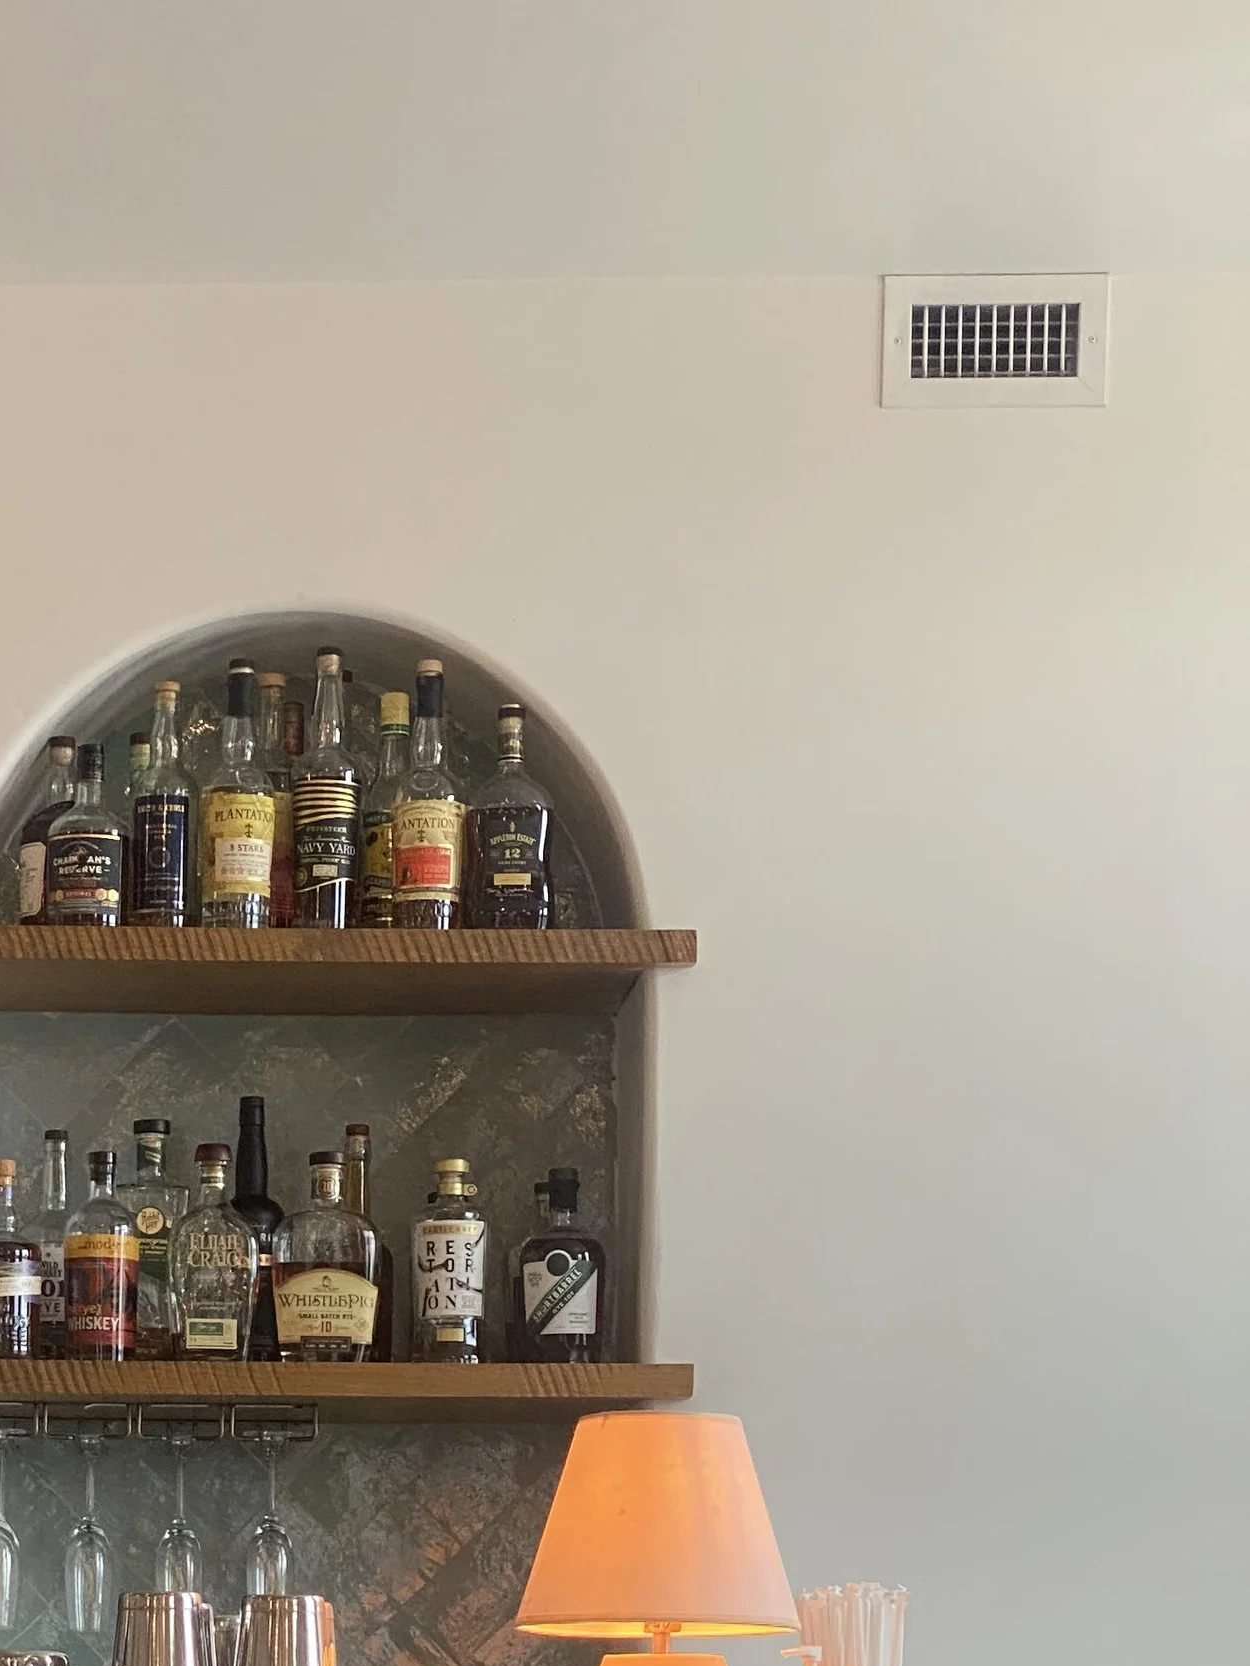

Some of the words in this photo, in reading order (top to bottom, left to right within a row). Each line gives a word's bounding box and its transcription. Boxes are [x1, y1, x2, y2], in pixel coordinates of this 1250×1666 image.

[400, 817, 456, 830] ANTATION
[237, 843, 264, 853] STARS
[297, 842, 325, 855] NAVY
[329, 842, 356, 856] YARD
[504, 847, 521, 859] 12
[53, 855, 112, 867] CHAIRAN'S
[190, 1232, 239, 1250] ELIJAH
[187, 1250, 240, 1268] CRAIG
[278, 1293, 374, 1310] WHISTLEPIG
[68, 1316, 121, 1331] WHISKEY
[320, 1321, 333, 1334] 10
